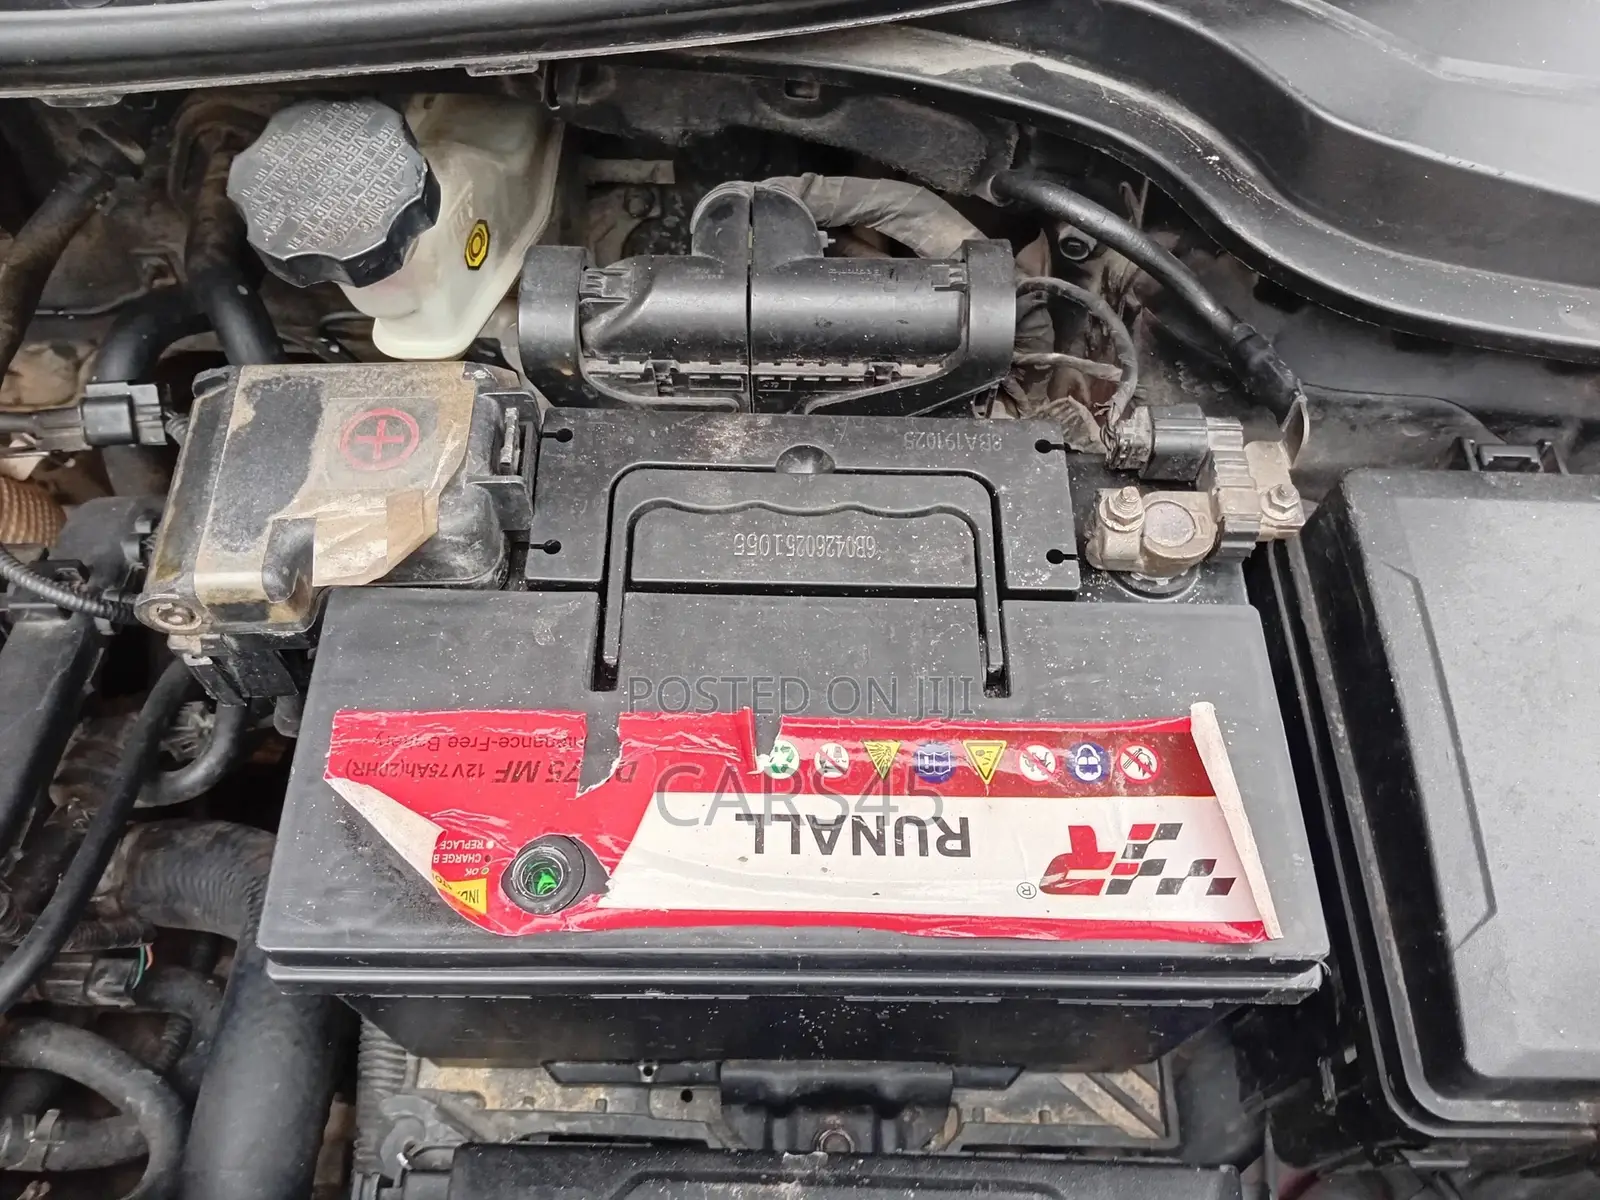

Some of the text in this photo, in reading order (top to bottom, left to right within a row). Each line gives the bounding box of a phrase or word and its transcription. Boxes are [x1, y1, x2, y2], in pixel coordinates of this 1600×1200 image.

[452, 761, 486, 779] 12V
[490, 760, 543, 784] MF
[735, 813, 972, 858] RUNALL
[440, 840, 485, 849] REPLACE
[442, 854, 482, 864] CHARGE
[464, 868, 479, 876] OK
